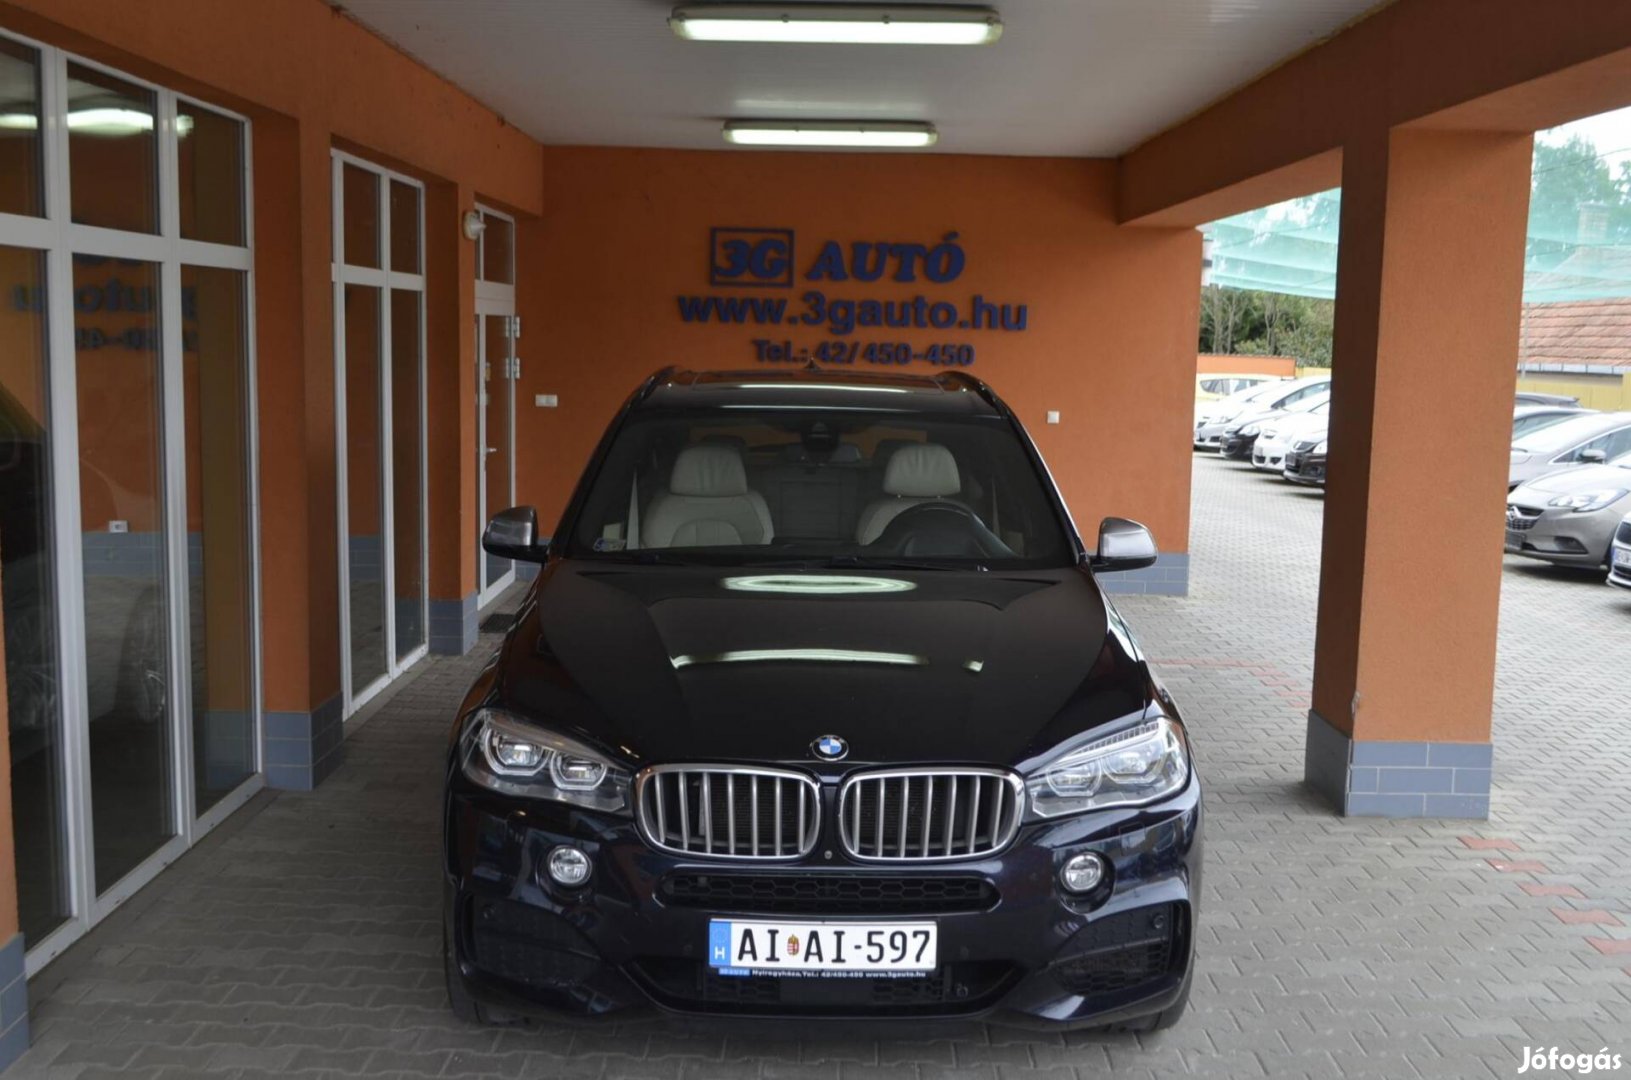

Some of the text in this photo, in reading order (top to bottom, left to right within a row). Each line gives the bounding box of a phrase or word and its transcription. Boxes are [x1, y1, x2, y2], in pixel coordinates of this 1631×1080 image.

[714, 230, 965, 283] 3G AUTÓ
[677, 290, 1028, 336] www.3gauto.hu
[751, 338, 808, 364] Tel.:
[714, 946, 725, 960] H
[803, 930, 931, 964] AI-597
